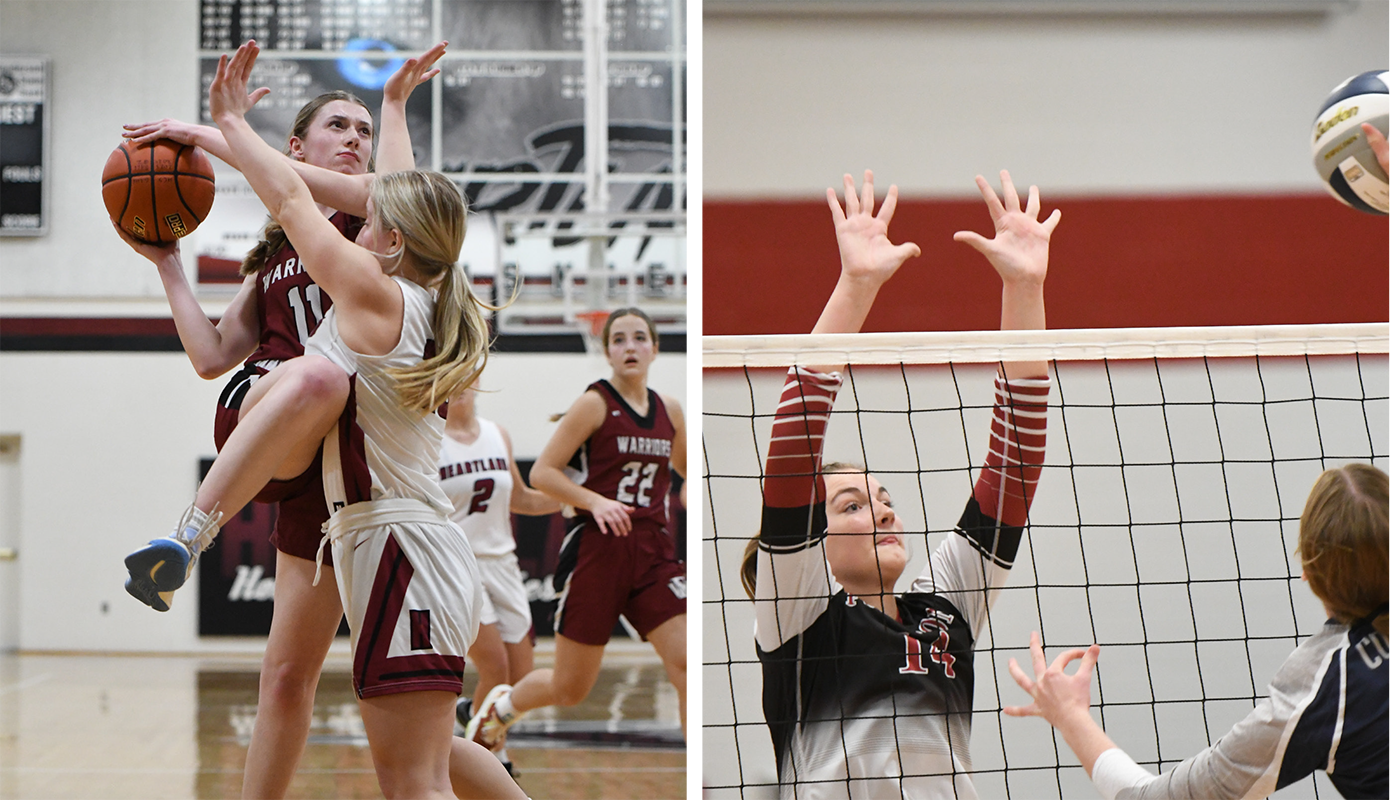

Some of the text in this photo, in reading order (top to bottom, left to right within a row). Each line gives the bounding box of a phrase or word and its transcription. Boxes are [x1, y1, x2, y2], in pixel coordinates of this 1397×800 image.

[287, 284, 324, 349] 11
[617, 436, 671, 458] WARRIORS
[467, 478, 495, 515] 2
[616, 461, 659, 507] 22
